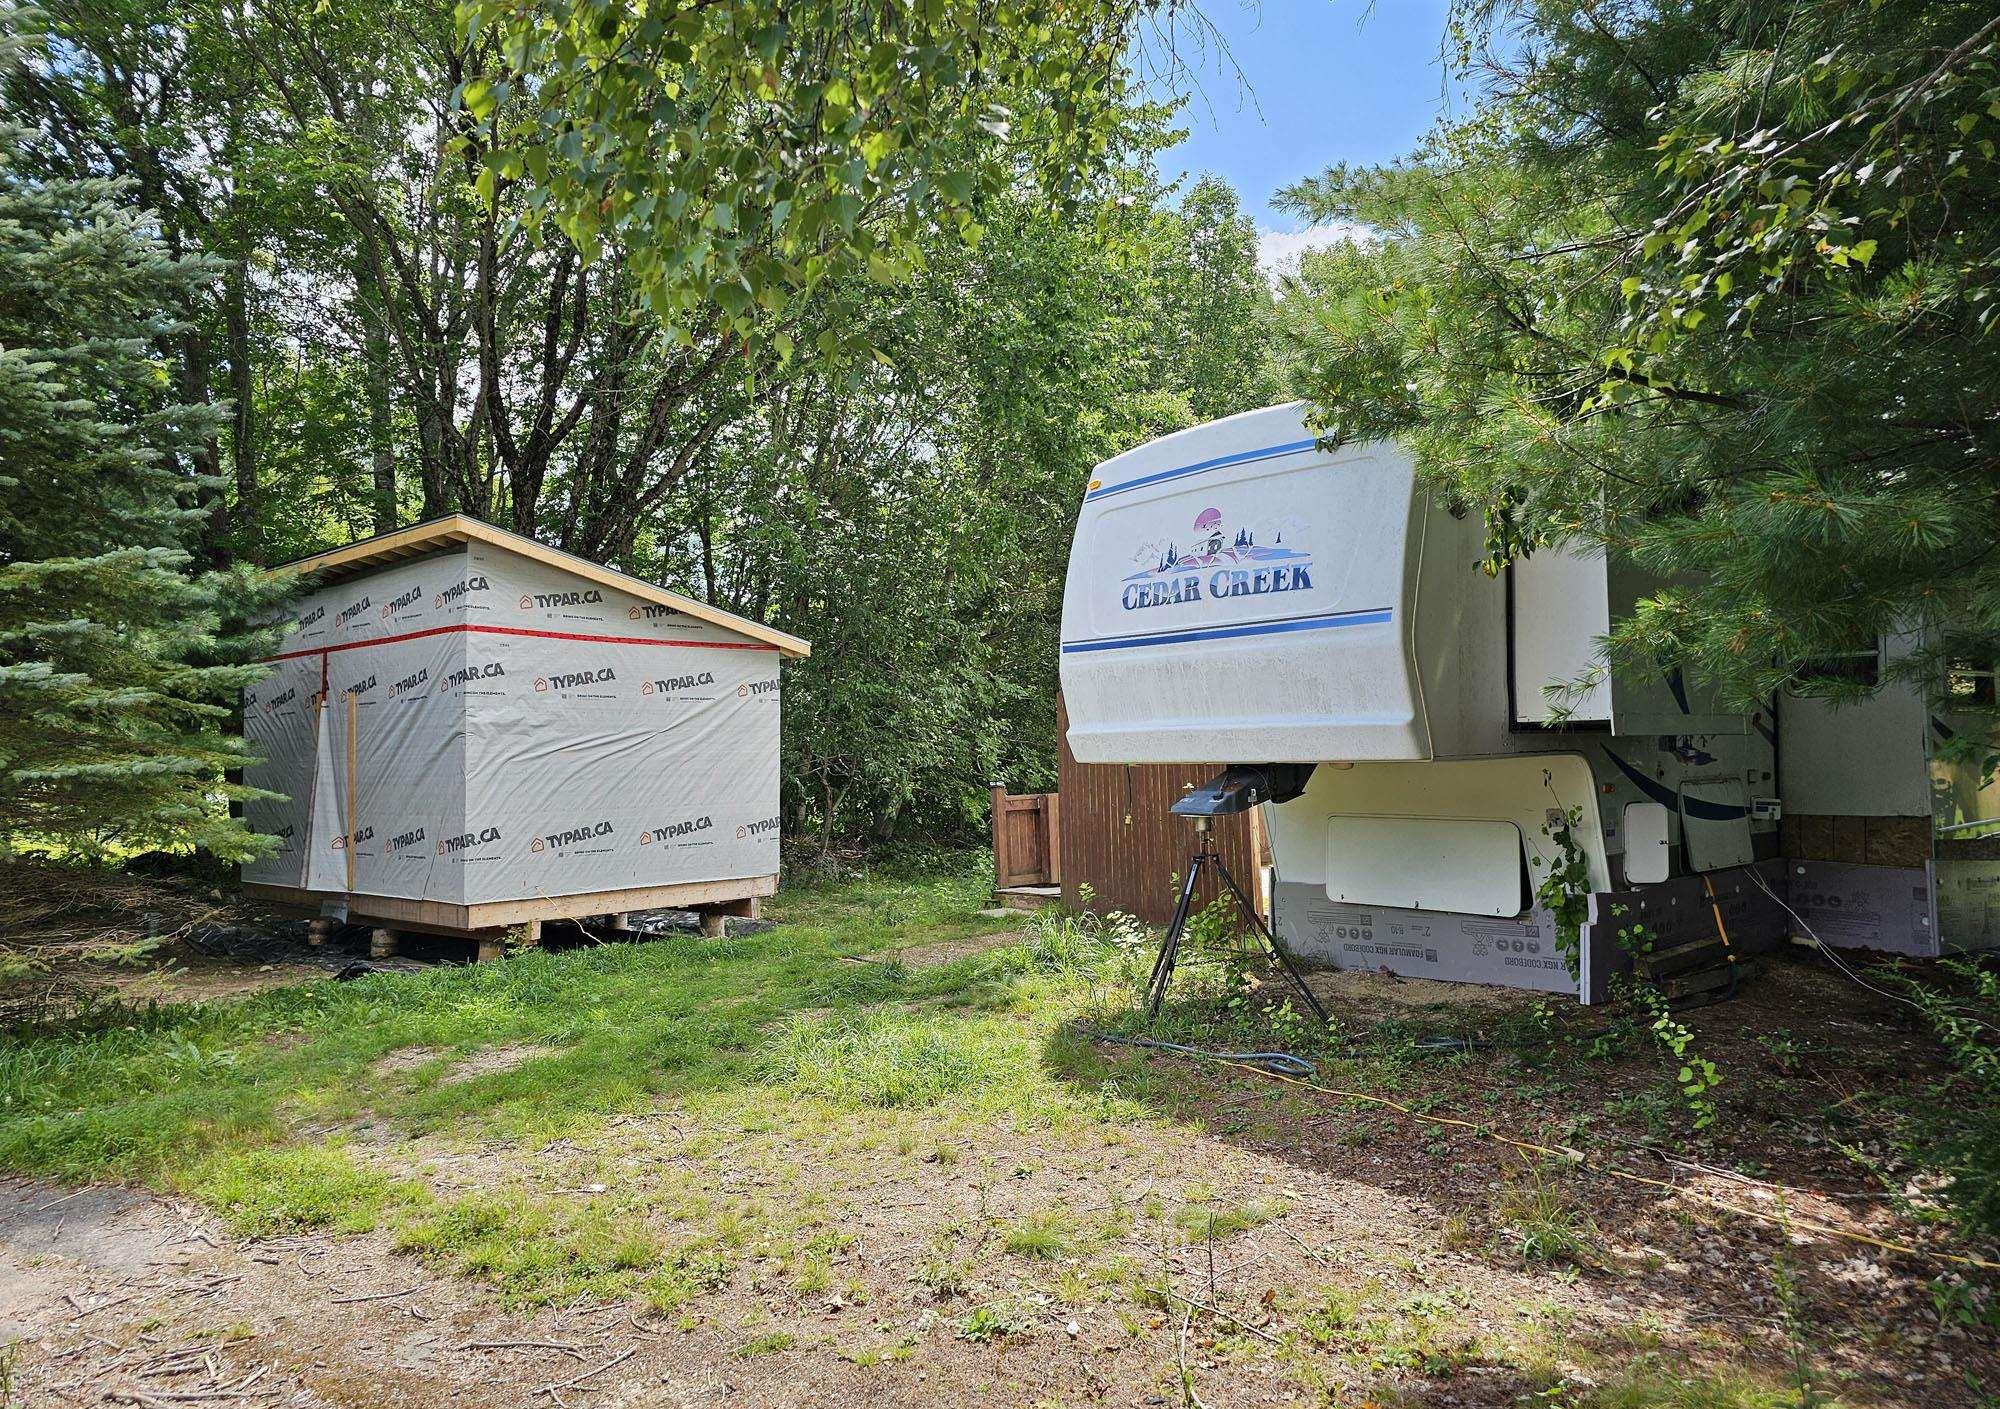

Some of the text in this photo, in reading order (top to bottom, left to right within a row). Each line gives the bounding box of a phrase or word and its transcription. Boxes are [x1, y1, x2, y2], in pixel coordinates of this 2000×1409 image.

[442, 576, 489, 604] TYPAR.CA
[534, 590, 603, 608] TYPAR.CA
[1122, 562, 1314, 611] CEDAR CREEK
[341, 596, 371, 623] TYPAR.CA
[389, 586, 422, 614] TYPAR.CA
[395, 668, 428, 695] TYPAR.CA
[449, 663, 505, 688] TYPAR.CA
[549, 668, 616, 689] TYPAR.CA
[655, 672, 714, 693] TYPAR.CA
[393, 828, 425, 850] TYPAR.CA
[445, 827, 501, 853] TYPAR.CA
[545, 821, 613, 848] TYPAR.CA
[653, 816, 712, 841] TYPAR.CA
[1389, 947, 1424, 958] FOAMULAR
[1504, 956, 1542, 968] CODEBORD
[1543, 960, 1559, 970] NGX
